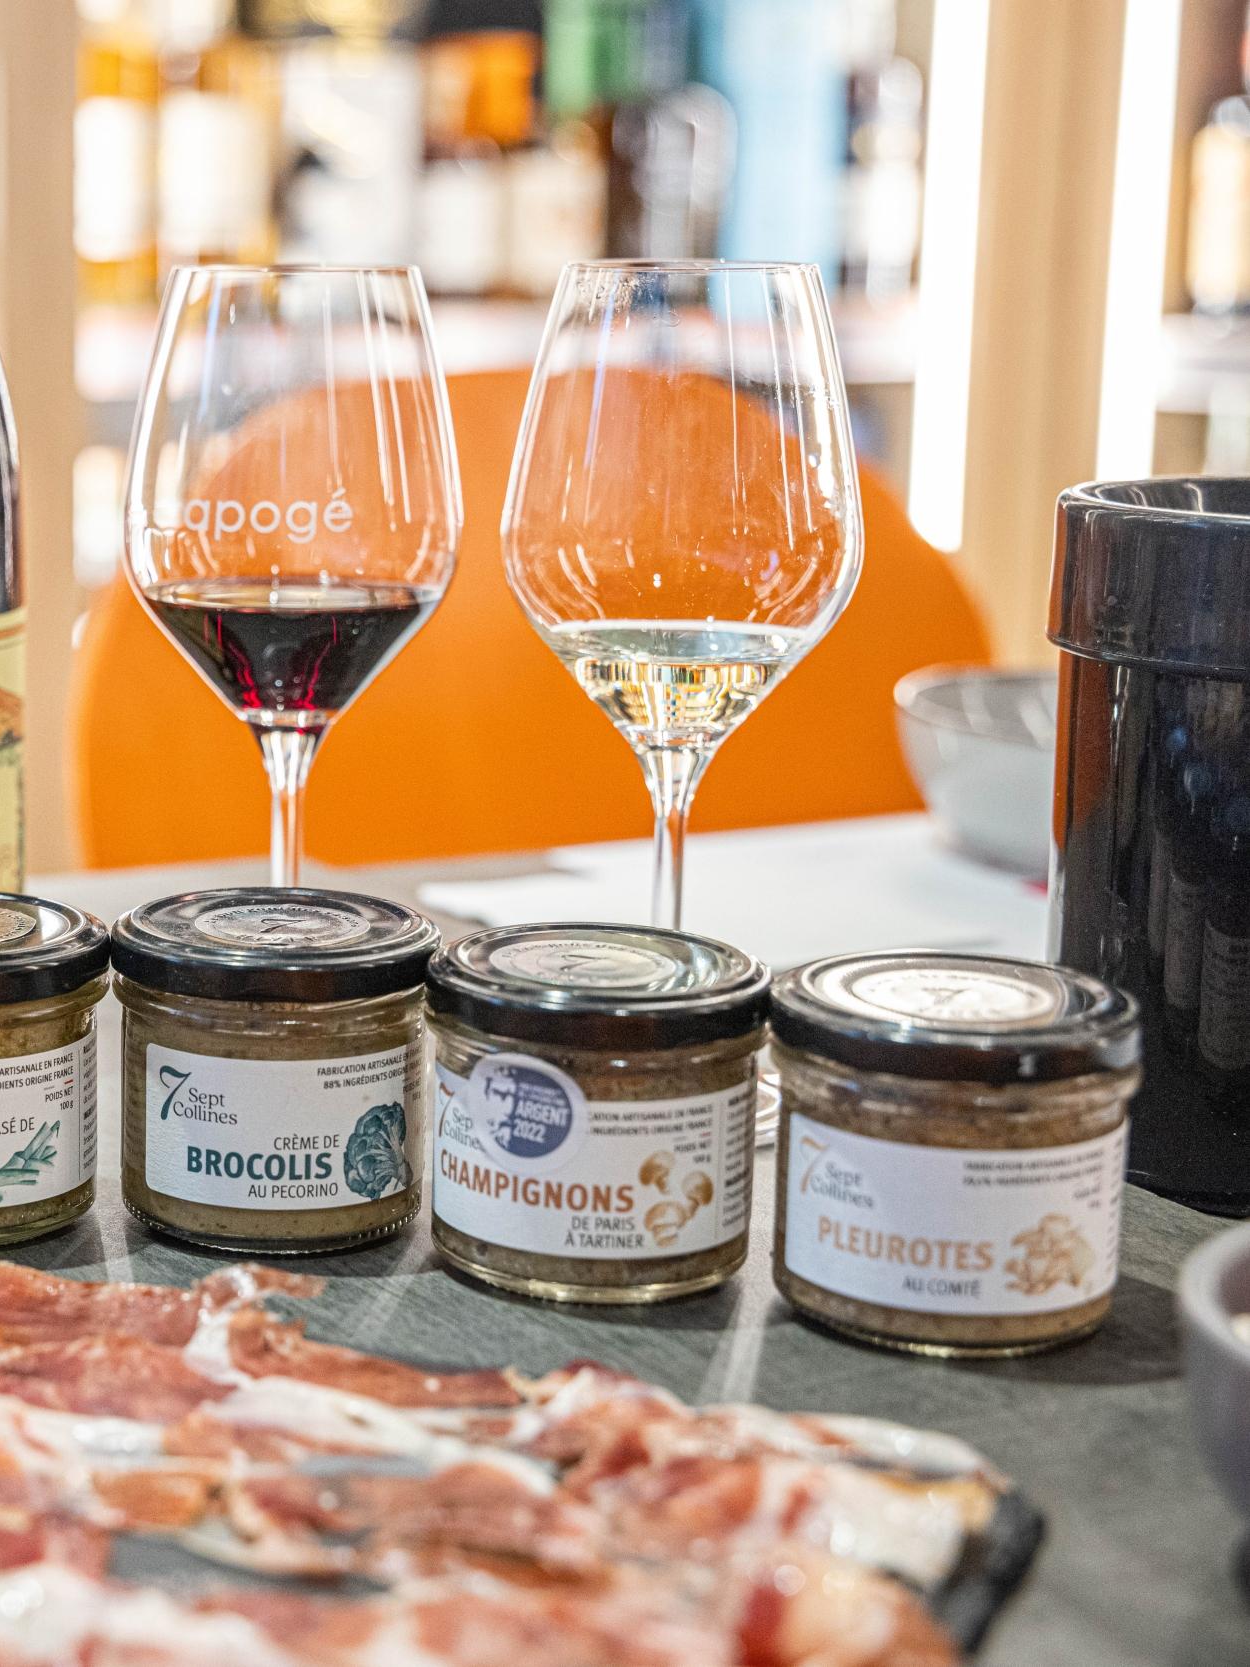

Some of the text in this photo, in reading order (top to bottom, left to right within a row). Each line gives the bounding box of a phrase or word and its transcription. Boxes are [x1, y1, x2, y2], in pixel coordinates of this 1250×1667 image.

[184, 487, 354, 544] apogé
[0, 1064, 43, 1077] ARTISANALE
[44, 1060, 52, 1069] EN
[53, 1053, 73, 1067] FRANCE
[25, 1072, 53, 1086] ORIGINE
[53, 1066, 73, 1080] FRANCE
[317, 1063, 366, 1076] FABRICATION
[367, 1054, 402, 1071] ARTISANALE
[323, 1079, 341, 1090] 88%
[343, 1070, 388, 1088] INGRÉDIENTS
[45, 1086, 73, 1103] POIDS NET
[159, 1065, 225, 1121] 7 Sept
[60, 1101, 70, 1111] 100
[173, 1101, 238, 1125] Collines
[515, 1100, 569, 1127] ARGENT
[20, 1117, 35, 1133] DE
[452, 1107, 473, 1131] Sep
[274, 1133, 340, 1150] CRÈME DE
[187, 1145, 333, 1181] BROCOLIS
[441, 1148, 635, 1213] CHAMPIGNONS
[824, 1162, 863, 1188] Sept
[248, 1183, 339, 1199] AU PECORINO
[572, 1216, 636, 1231] DE PARIS
[564, 1229, 645, 1248] À TARTINER
[818, 1216, 995, 1271] PLEUROTES
[902, 1276, 981, 1297] AU COMTÉ
